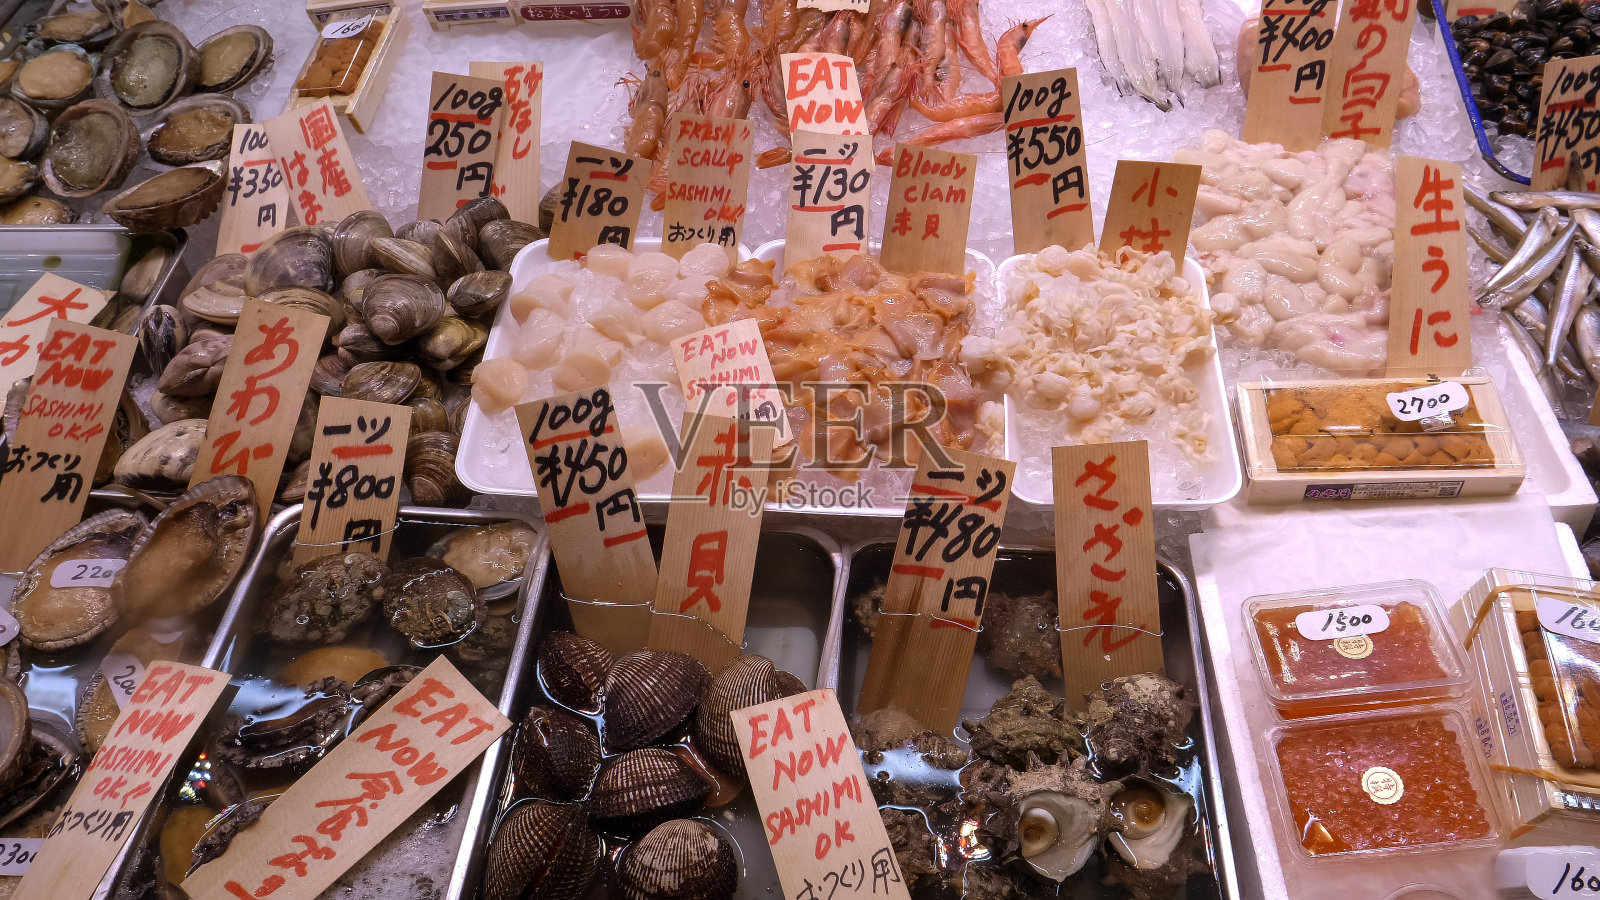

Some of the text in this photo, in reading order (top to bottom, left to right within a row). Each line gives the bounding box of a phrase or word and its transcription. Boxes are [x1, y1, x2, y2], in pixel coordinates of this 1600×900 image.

[331, 22, 365, 34] 1600
[1259, 14, 1334, 65] ¥400
[787, 57, 852, 100] EAT
[1294, 60, 1326, 93] 円
[433, 83, 503, 120] 100g
[504, 64, 543, 160] 砂なし
[790, 99, 864, 132] NOW
[1004, 77, 1071, 124] 100g
[300, 105, 352, 197] 国産
[424, 119, 492, 158] 250
[1007, 125, 1081, 176] ¥550
[228, 162, 282, 206] ¥350
[456, 162, 493, 198] 円
[896, 148, 967, 180] Bloody
[560, 177, 629, 222] ¥180
[667, 182, 731, 203] SASHIMI
[793, 165, 870, 207] ¥130
[1052, 166, 1084, 204] 円
[257, 203, 277, 227] 円
[667, 221, 736, 247] おつくり用
[831, 205, 865, 240] 円
[892, 207, 941, 241] 赤貝
[598, 226, 630, 250] 円
[1410, 164, 1460, 356] 生うに
[40, 330, 117, 365] EAT
[681, 329, 729, 362] EAT
[711, 338, 757, 370] NOW
[36, 361, 114, 392] NOW
[210, 317, 299, 475] あわび
[22, 394, 104, 421] SASHIMI
[529, 388, 615, 444] 100g
[1396, 393, 1450, 415] 2700
[534, 438, 628, 507] ¥450
[307, 461, 395, 530] ¥800
[596, 488, 641, 531] 円
[341, 518, 382, 552] 円
[679, 422, 753, 614] 赤貝
[903, 496, 1001, 562] ¥480
[1074, 454, 1147, 653] さざえ
[940, 576, 988, 617] 円
[1321, 611, 1373, 632] 1500
[129, 664, 215, 706] EAT
[114, 708, 195, 744] NOW
[393, 677, 495, 745] EAT
[749, 700, 817, 760] EAT
[87, 745, 172, 778] SASHIMI
[356, 723, 449, 786] NOW
[772, 732, 848, 791] NOW
[765, 774, 863, 846] SASHIMI
[814, 820, 856, 860] OK
